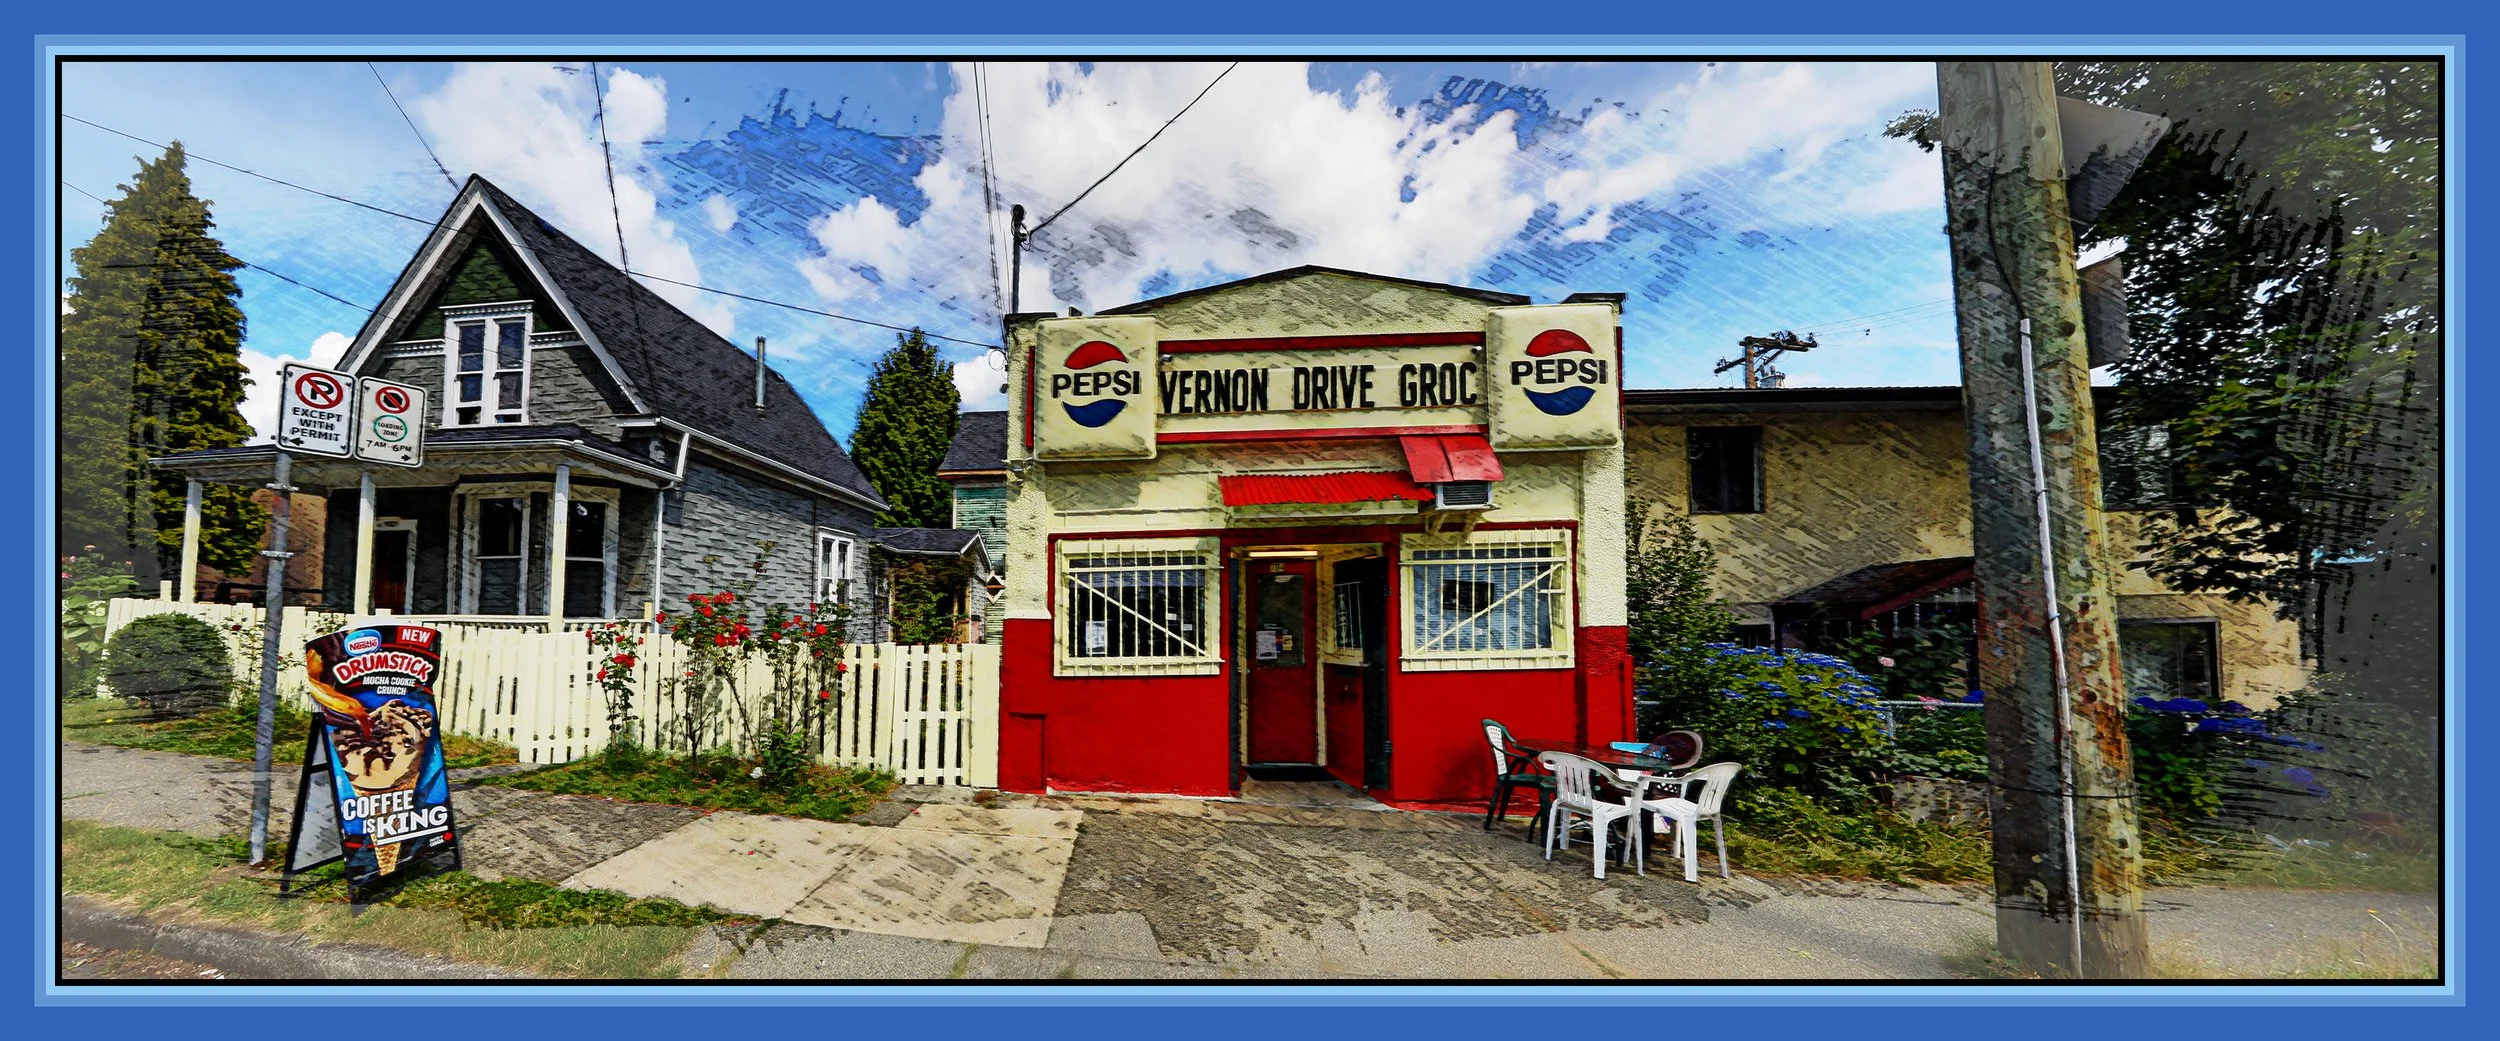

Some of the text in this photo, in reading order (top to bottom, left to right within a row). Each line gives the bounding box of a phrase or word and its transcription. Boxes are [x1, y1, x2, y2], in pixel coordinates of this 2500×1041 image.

[1509, 358, 1608, 386] PEPSI
[1051, 369, 1141, 399] PEPSI
[1159, 361, 1478, 414] VERNON DRIVE GROC
[292, 406, 343, 422] EXCEPT
[300, 418, 335, 431] WITH
[377, 421, 404, 431] LOADING
[290, 427, 341, 442] PERMIT
[382, 429, 399, 437] ZONE
[401, 628, 431, 644] NEW
[335, 653, 432, 682] DRUMSTICK
[362, 676, 417, 687] MOCHA COOKIE
[376, 686, 407, 696] CRUNCH
[342, 789, 415, 821] COFFEE
[362, 805, 449, 839] IS KING
